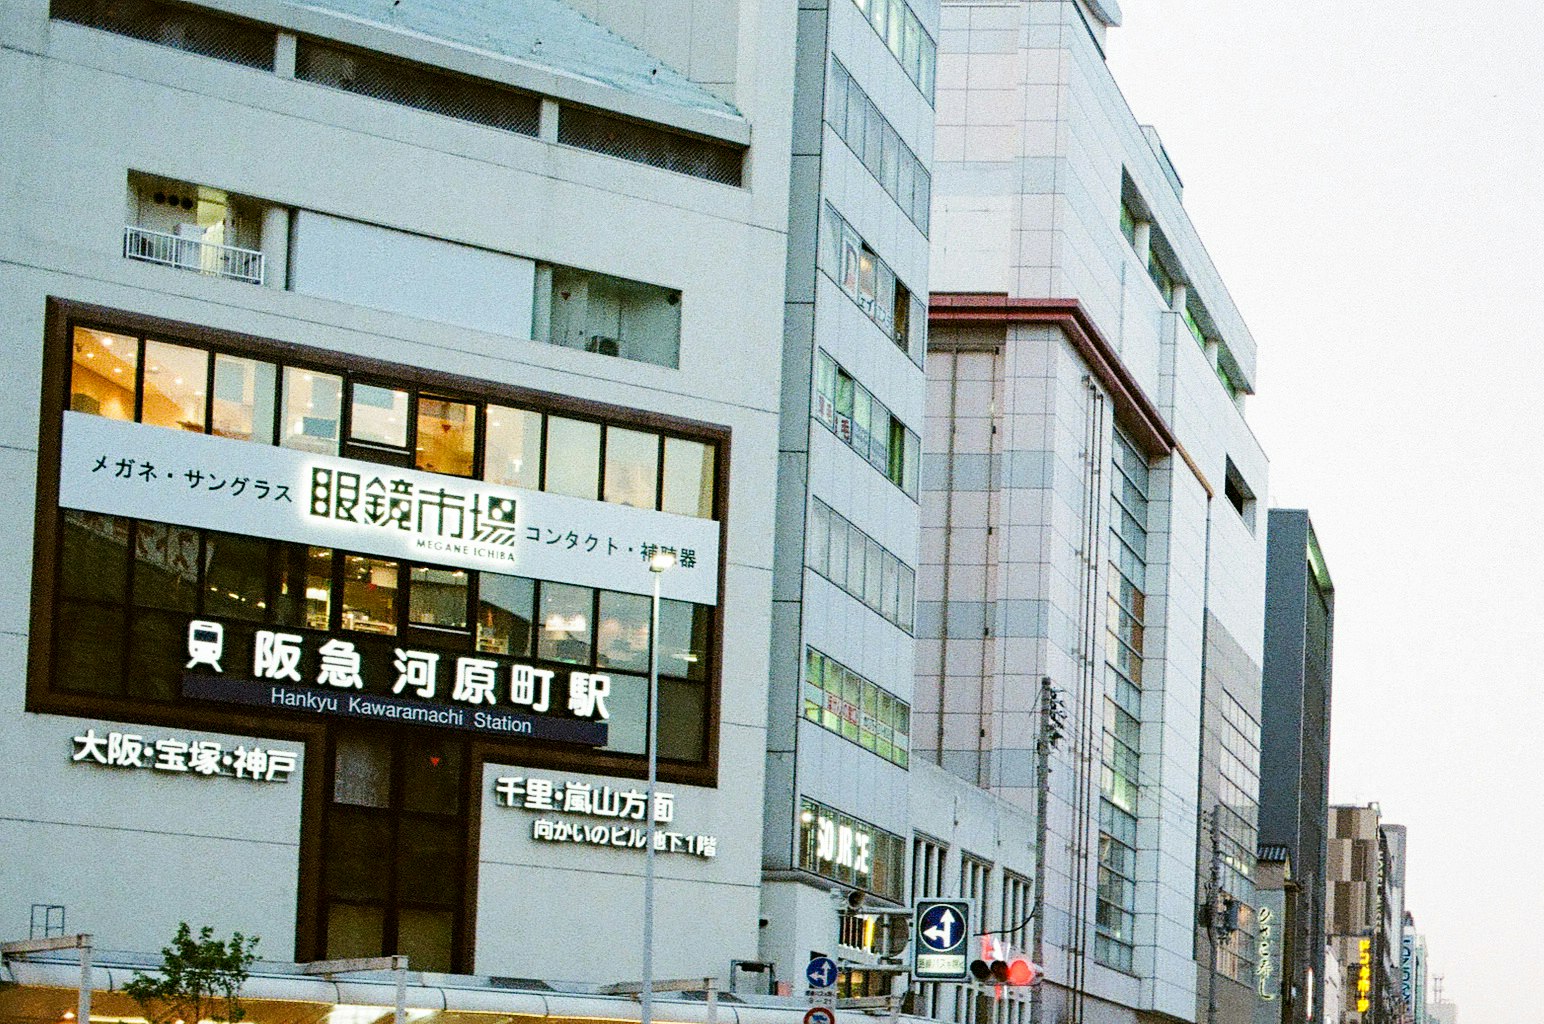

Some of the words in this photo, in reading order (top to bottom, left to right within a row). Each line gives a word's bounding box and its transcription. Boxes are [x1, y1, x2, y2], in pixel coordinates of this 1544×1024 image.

[91, 454, 293, 503] メガネ・サングラス
[309, 466, 517, 547] 眼鏡市場
[416, 539, 470, 555] MEGANE
[473, 547, 516, 562] ICHIBA
[253, 629, 364, 690] 阪急
[392, 646, 611, 720] 河原町駅
[271, 687, 339, 713] Hankyu
[347, 695, 463, 727] Kawaramachi
[473, 711, 532, 735] Station
[72, 728, 298, 781] 大阪・宝塚・神戸
[495, 776, 675, 822] 千里・嵐山方面
[533, 818, 717, 858] 向かいのビル地下1階
